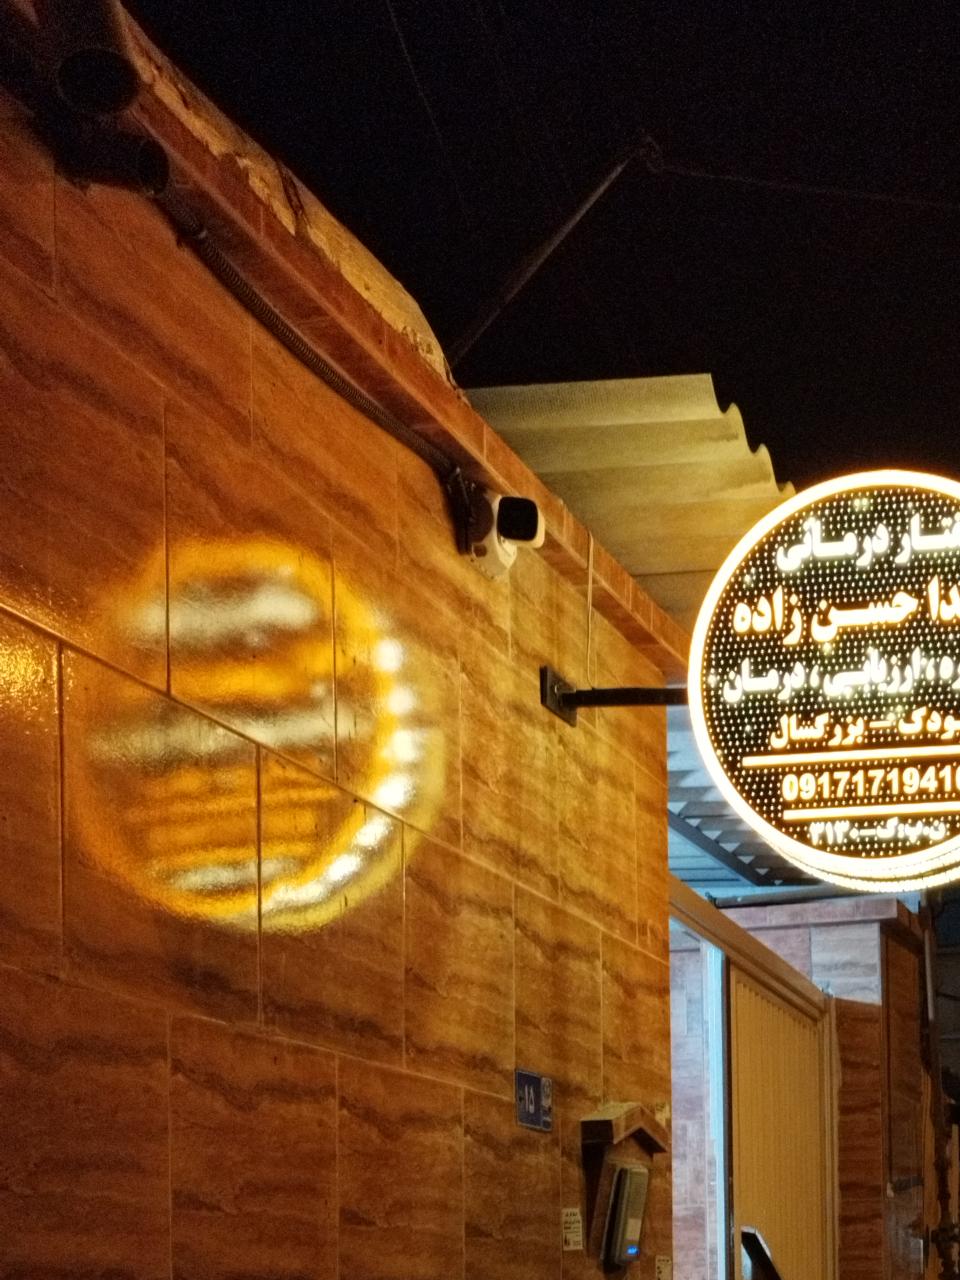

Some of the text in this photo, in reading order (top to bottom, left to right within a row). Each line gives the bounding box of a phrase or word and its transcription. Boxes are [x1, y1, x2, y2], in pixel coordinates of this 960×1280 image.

[776, 517, 890, 572] درمانی
[733, 585, 803, 645] زاده
[723, 657, 805, 703] درمان
